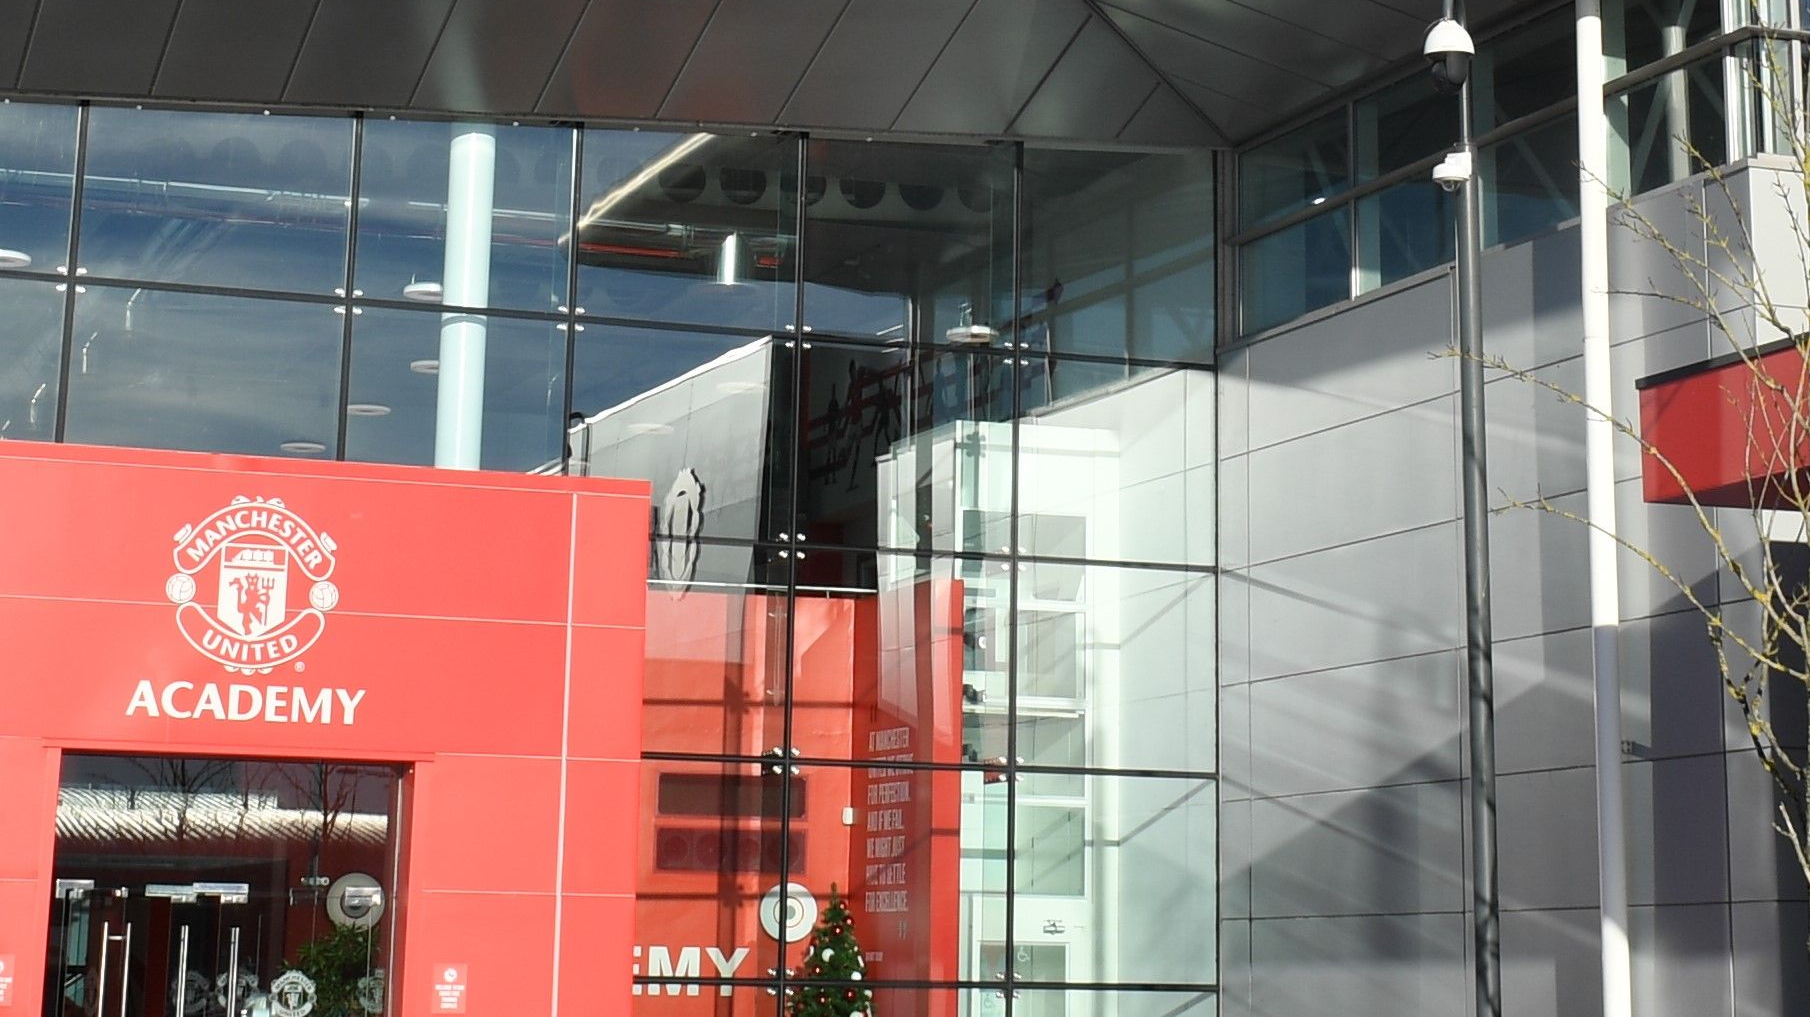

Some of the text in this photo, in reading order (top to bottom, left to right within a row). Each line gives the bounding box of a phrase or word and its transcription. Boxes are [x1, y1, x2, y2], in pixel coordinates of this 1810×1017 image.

[186, 510, 323, 570] MANCHESTER
[202, 629, 299, 662] UNITED
[125, 679, 367, 726] ACADEMY
